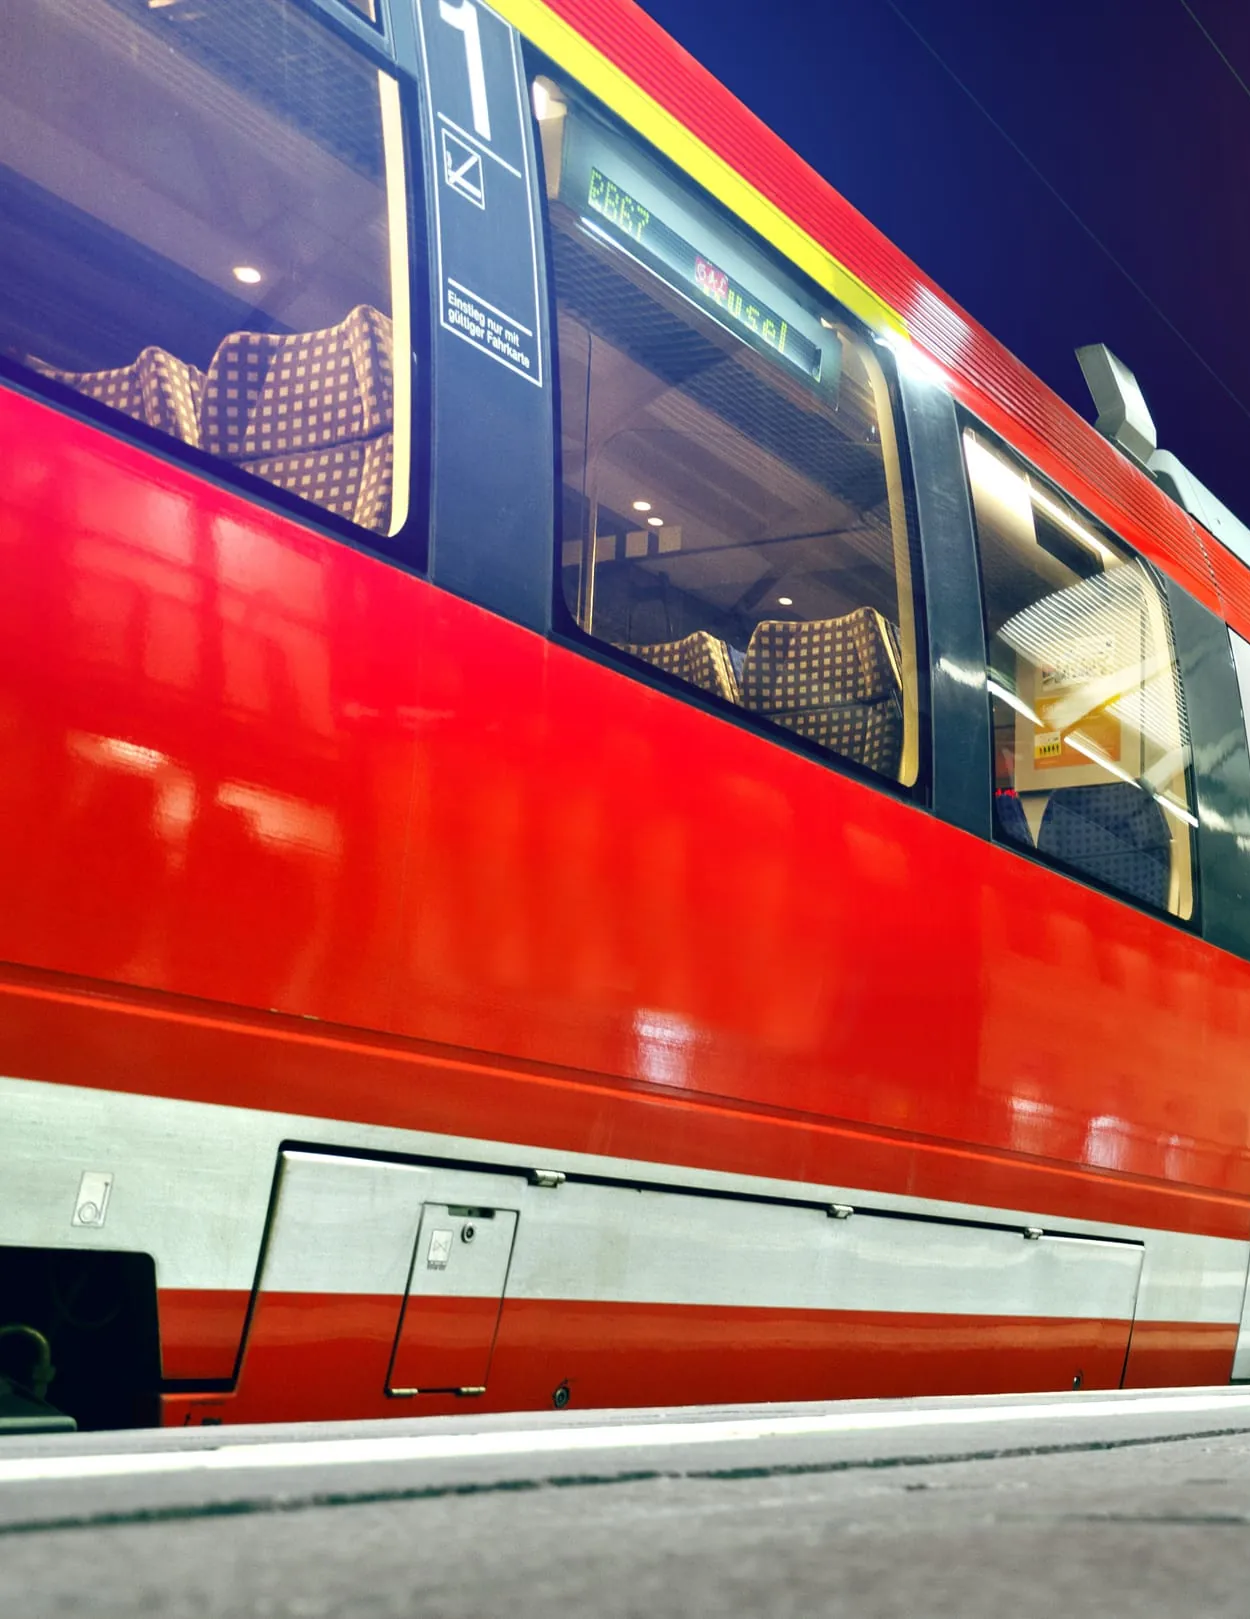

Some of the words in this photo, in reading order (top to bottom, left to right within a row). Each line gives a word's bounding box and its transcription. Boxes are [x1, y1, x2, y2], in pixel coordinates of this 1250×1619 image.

[438, 0, 491, 141] 1
[447, 289, 485, 328] Einstieg
[487, 318, 503, 336] nur
[504, 330, 520, 347] mit
[448, 308, 485, 340] gültiger
[487, 330, 530, 369] Fahrkarte
